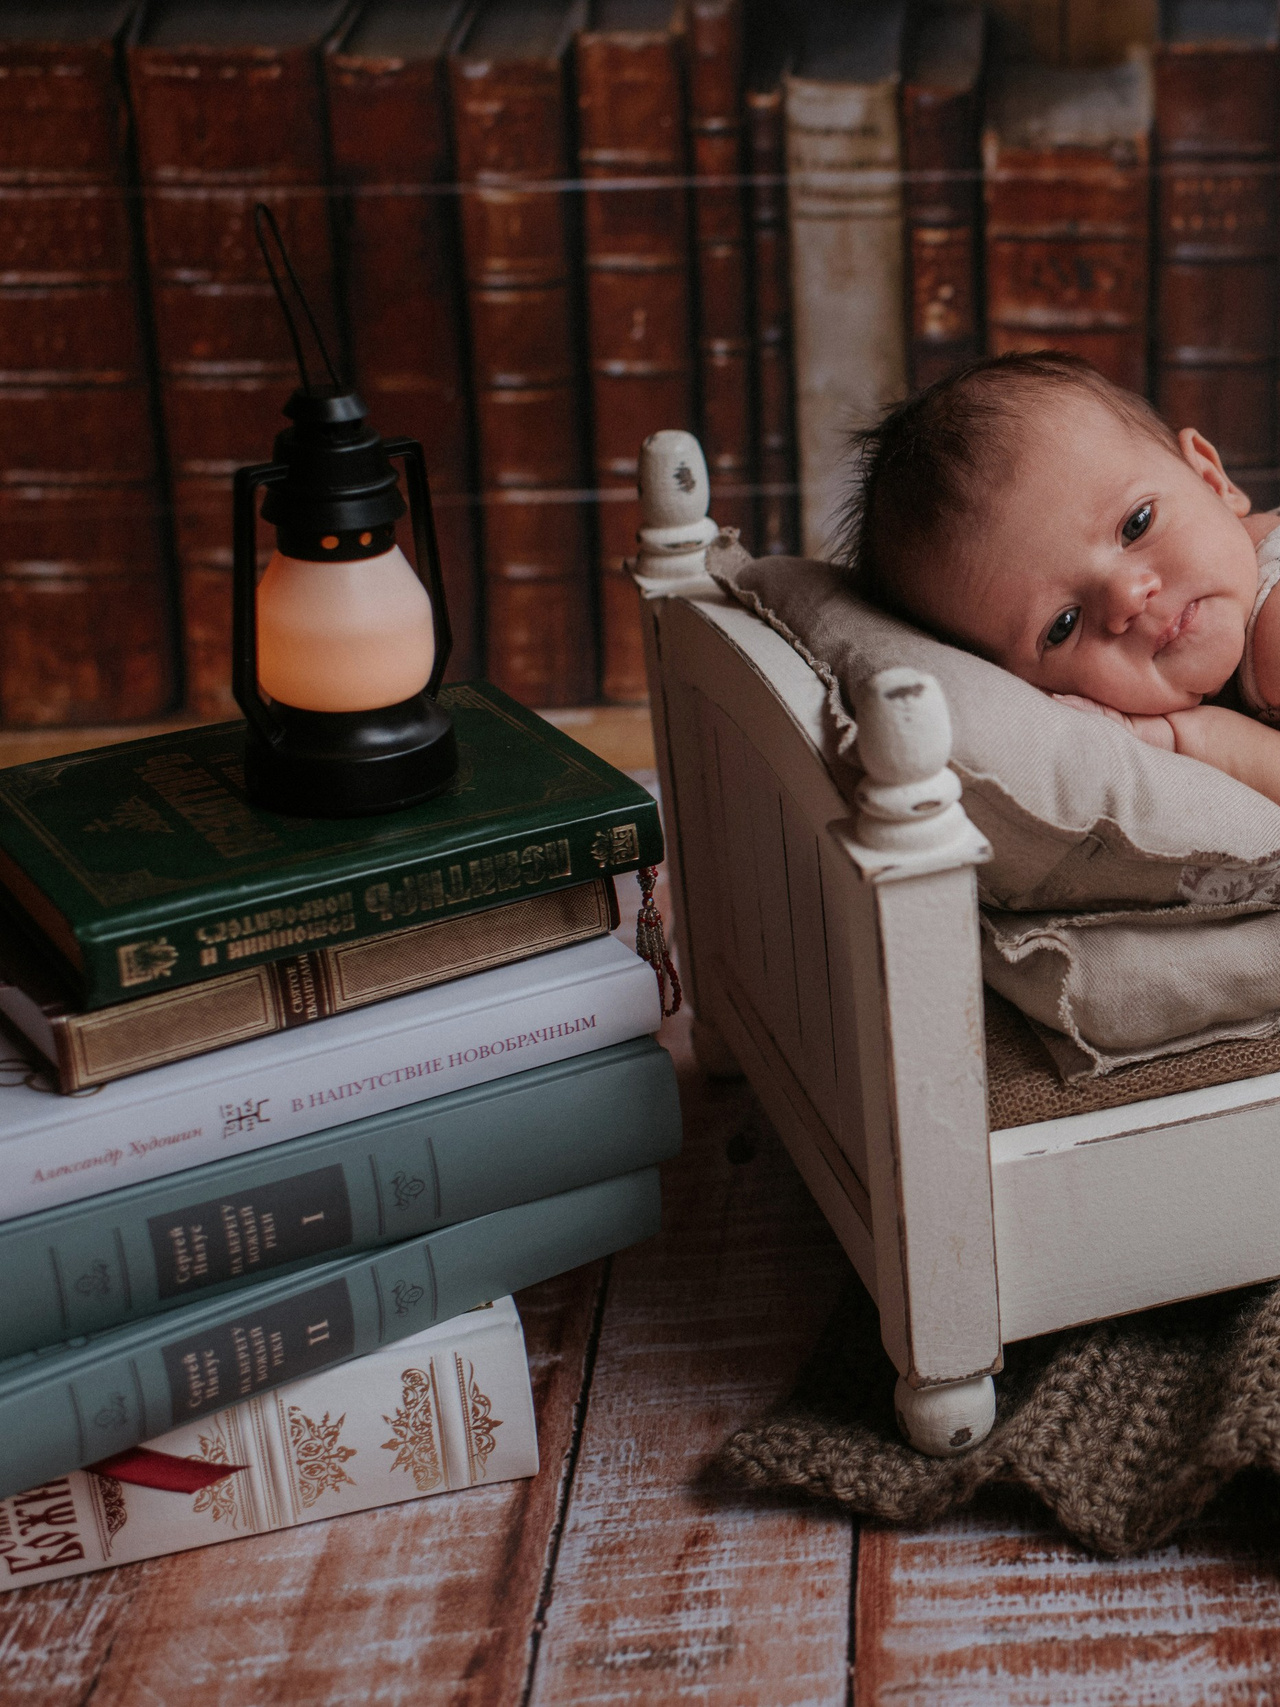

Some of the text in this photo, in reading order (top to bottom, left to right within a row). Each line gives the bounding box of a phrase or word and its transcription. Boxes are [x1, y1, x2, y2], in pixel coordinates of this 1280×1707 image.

[363, 838, 572, 921] ПСАЛТИРЬ
[196, 892, 354, 944] ПОКРОВИТЕЛЬ
[200, 913, 356, 966] ПОМОЩНИК И
[286, 966, 303, 1013] СВЯТОЕ
[291, 1014, 598, 1113] В НАПУТСТВИЕ НОВОБРАЧНЫМ
[32, 1148, 124, 1184] Александр
[169, 1226, 192, 1284] Сергей
[191, 1224, 208, 1276] Нилус
[221, 1204, 243, 1274] НА БЕРЕГУ
[240, 1205, 260, 1263] БОЖЬЕЙ
[260, 1212, 277, 1249] РЕКИ
[250, 1326, 268, 1382] БОЖЬЕЙ
[270, 1331, 284, 1367] РЕКИ
[307, 1319, 330, 1346] II
[183, 1352, 206, 1408] Сергей
[203, 1350, 220, 1399] Нилус
[231, 1327, 251, 1394] НА БЕРЕГУ
